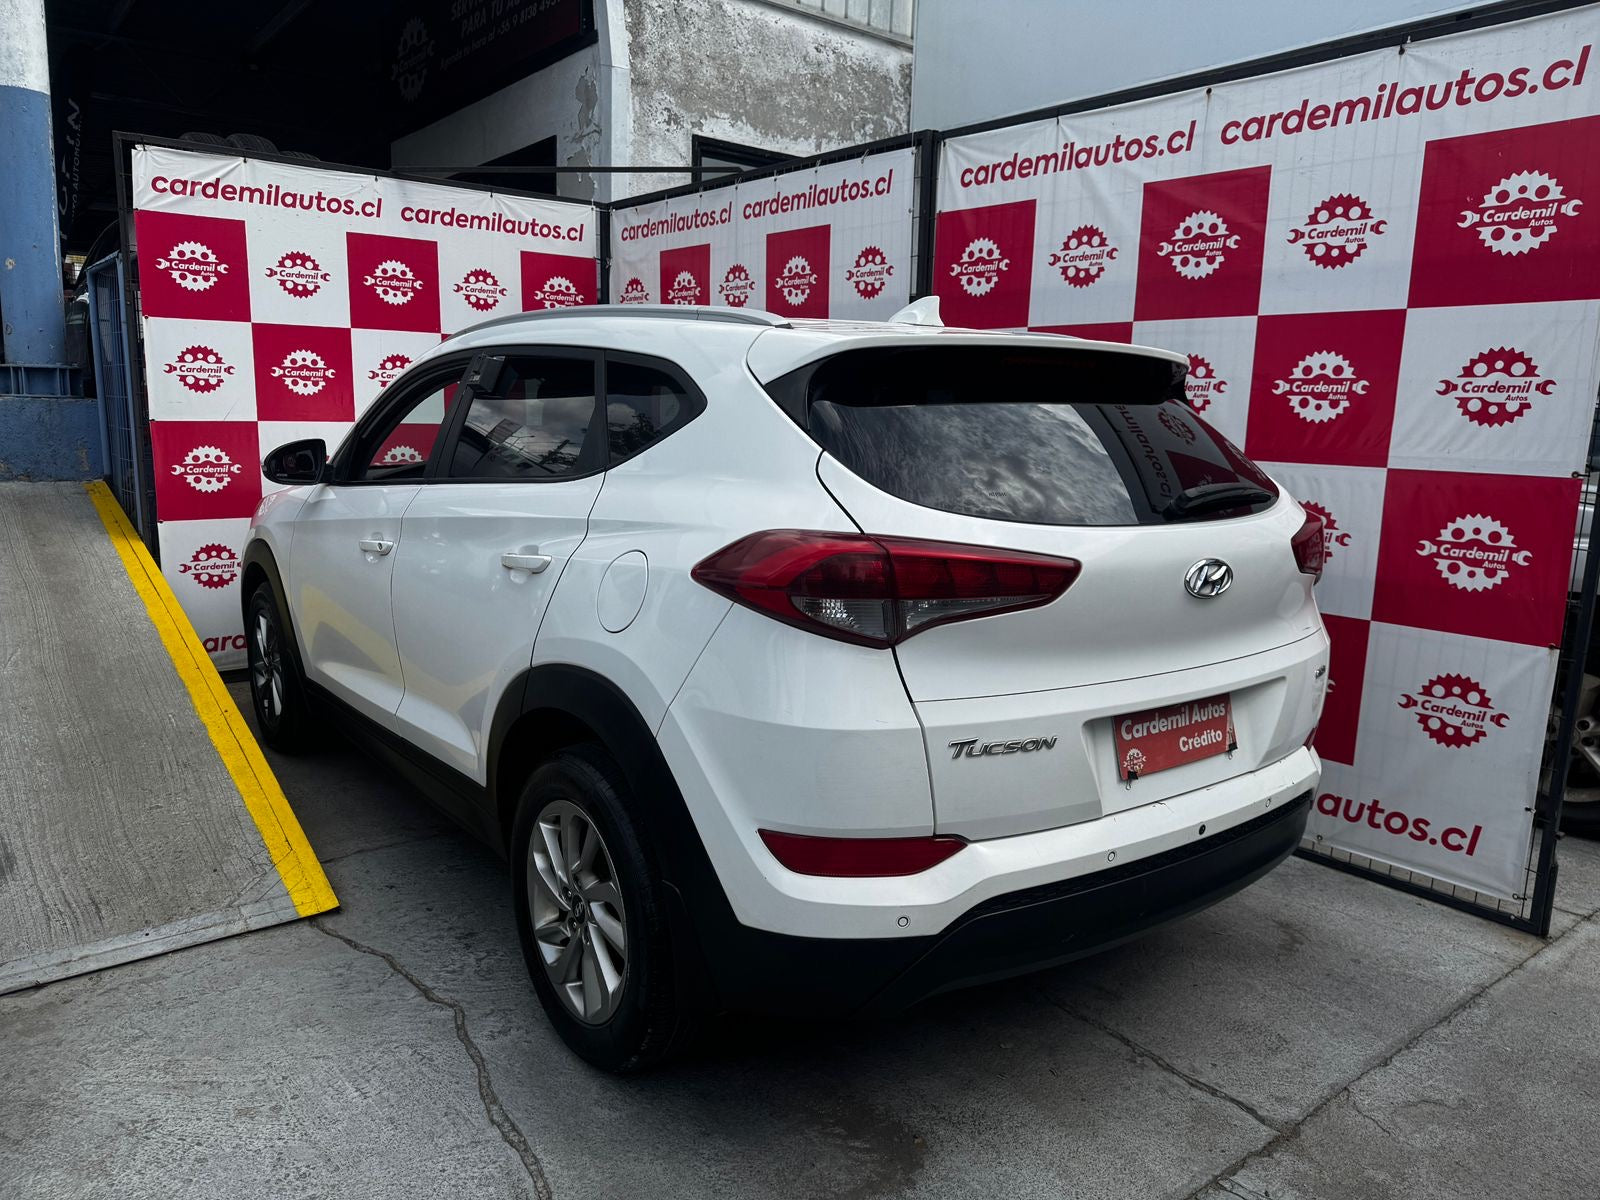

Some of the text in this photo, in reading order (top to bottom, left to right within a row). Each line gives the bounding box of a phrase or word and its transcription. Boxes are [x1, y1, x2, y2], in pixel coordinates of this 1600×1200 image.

[1220, 44, 1592, 145] cardemilautos.cl
[960, 120, 1197, 188] cardemilautos.cl
[151, 176, 382, 218] cardemilautos.cl
[743, 169, 893, 220] cardemilautos.cl
[1482, 203, 1558, 223] Cardemil
[400, 207, 584, 241] cardemilautos.cl
[621, 201, 732, 242] cardemilautos.cl
[1528, 218, 1554, 227] Autos
[1307, 223, 1367, 240] Cardemil
[1174, 237, 1225, 252] Cardemil
[1344, 236, 1365, 244] Autos
[1063, 250, 1104, 263] Cardemil
[172, 260, 216, 272] Cardemil
[962, 260, 998, 273] Cardemil
[279, 269, 319, 281] Cardemil
[855, 267, 885, 278] Cardemil
[376, 278, 413, 288] Cardemil
[725, 282, 749, 292] Cardemil
[783, 276, 809, 286] Cardemil
[464, 285, 498, 295] Cardemil
[545, 293, 575, 302] Cardemil
[179, 364, 222, 374] Cardemil
[284, 368, 324, 378] Cardemil
[1292, 381, 1350, 393] Cardemil
[1461, 380, 1533, 394] Cardemil
[1504, 394, 1528, 402] Autos
[186, 465, 229, 474] Cardemil
[1439, 543, 1509, 562] Cardemil
[193, 561, 235, 572] Cardemil
[1482, 560, 1506, 570] Autos
[1420, 699, 1487, 722] Cardemil
[1121, 703, 1225, 741] Cardemil Autos
[1460, 719, 1484, 730] Autos
[1179, 730, 1223, 752] Crédito
